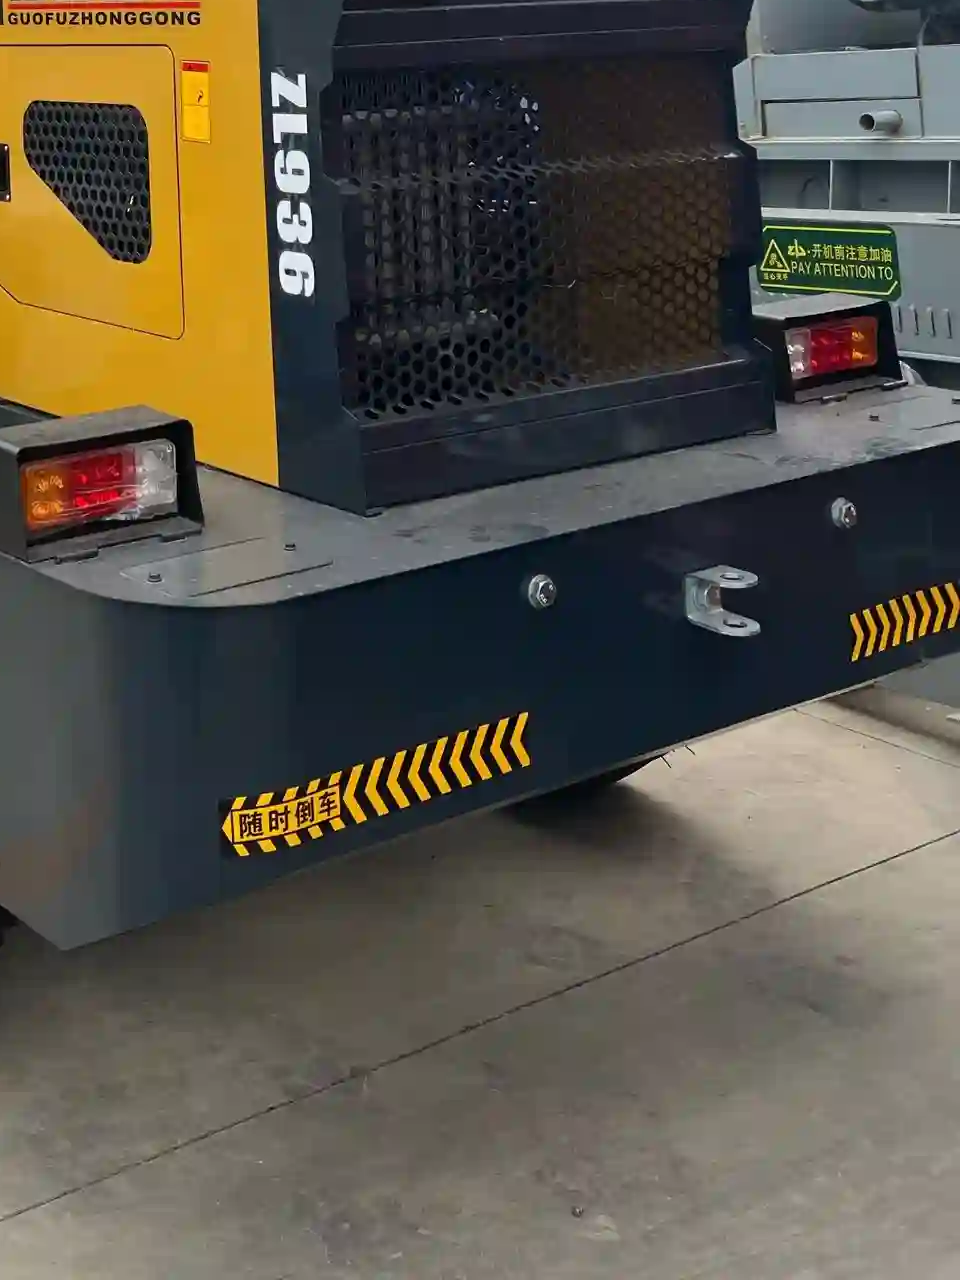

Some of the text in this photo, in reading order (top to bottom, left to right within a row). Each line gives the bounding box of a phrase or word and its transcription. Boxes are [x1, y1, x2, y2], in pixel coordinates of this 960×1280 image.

[7, 11, 201, 26] GUOFUZHONGGONG
[271, 71, 315, 298] ZL936
[791, 261, 894, 280] PAY ATTENTION TO
[239, 791, 338, 838] 随时倒车
